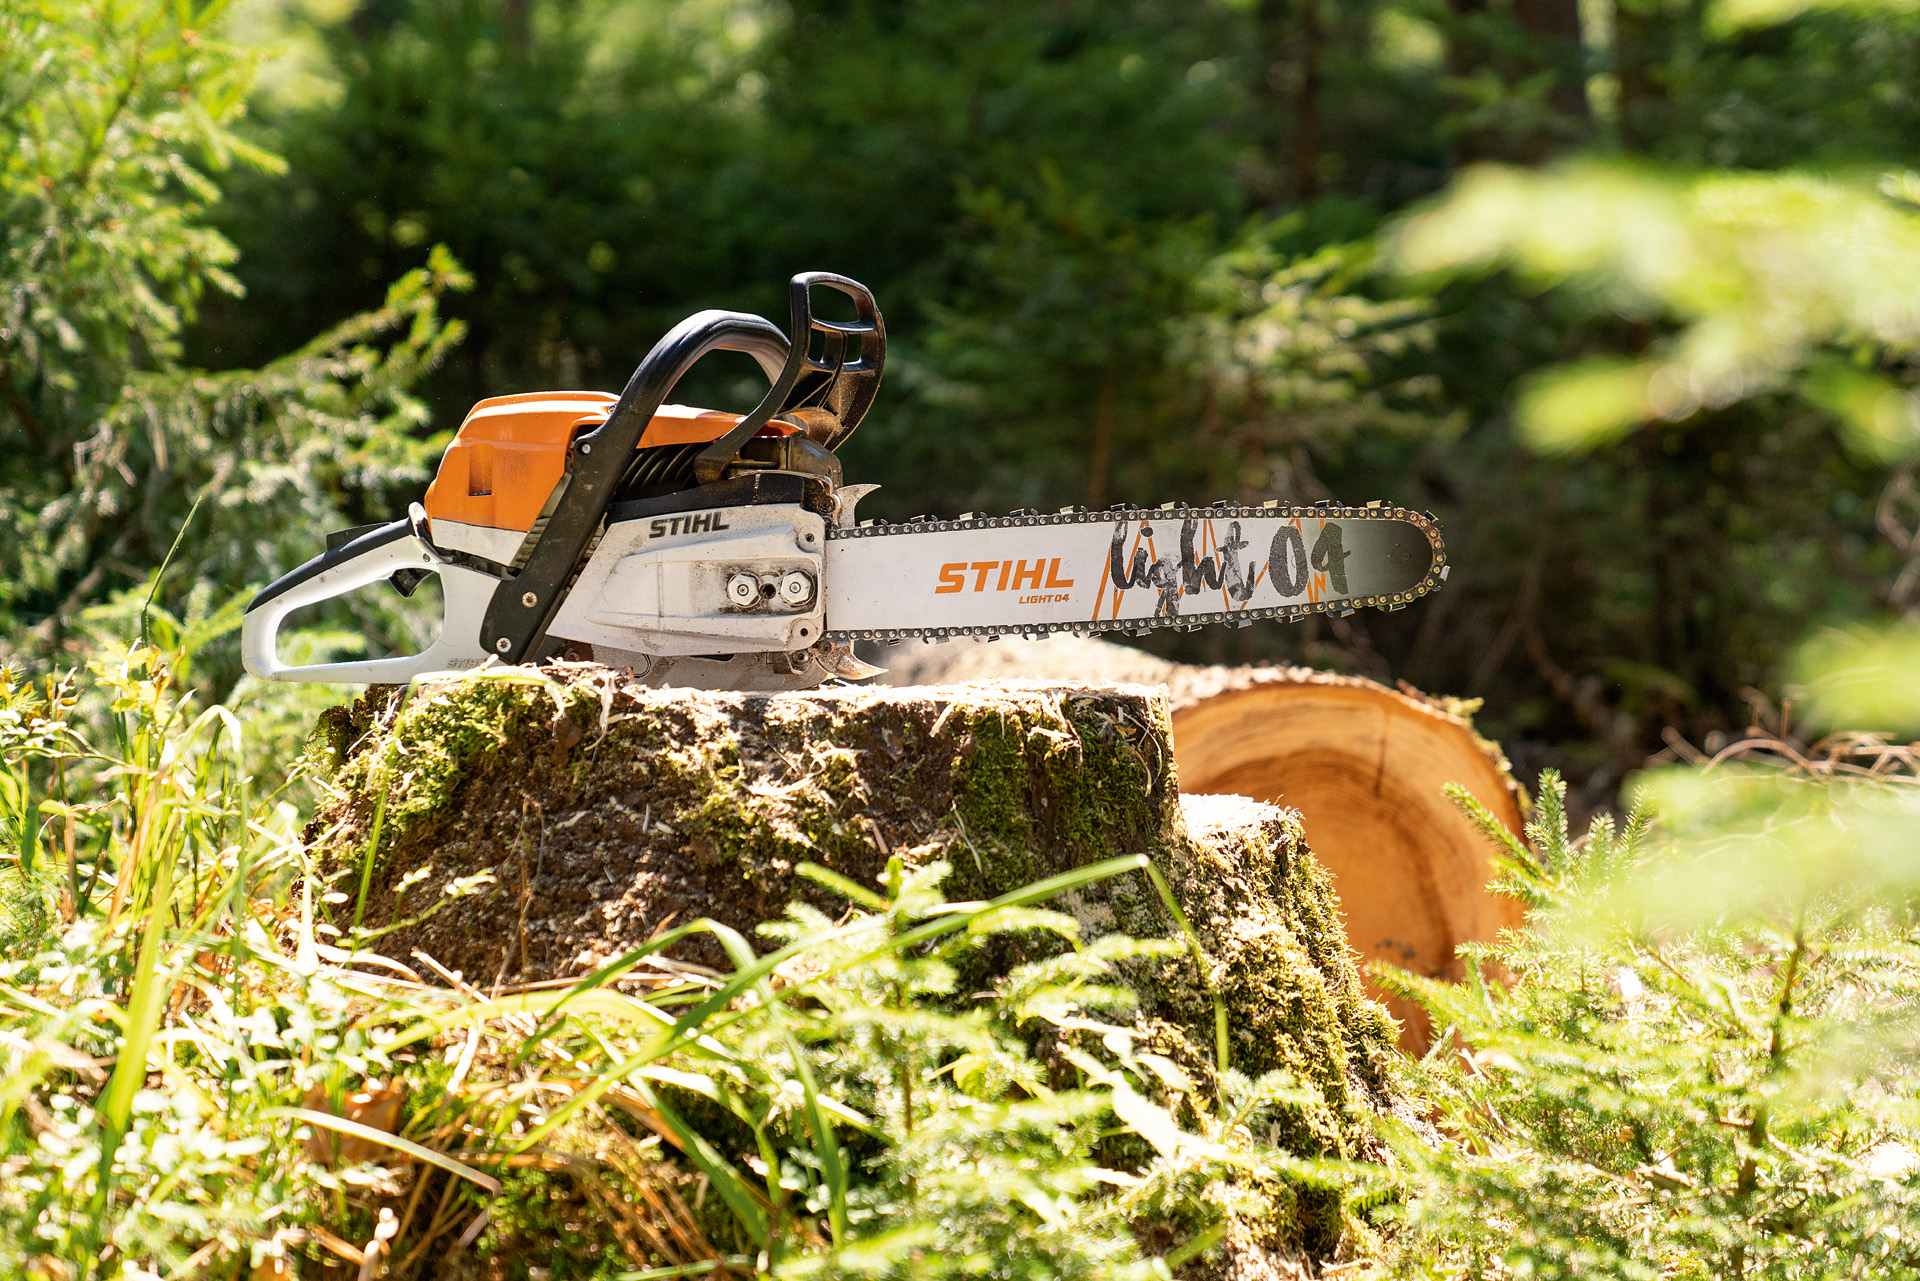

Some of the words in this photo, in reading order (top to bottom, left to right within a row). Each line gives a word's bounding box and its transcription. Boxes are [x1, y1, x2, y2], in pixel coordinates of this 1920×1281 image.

[649, 511, 730, 539] STIHL
[934, 557, 1075, 595] STIHL
[1110, 519, 1256, 618] light
[1268, 521, 1352, 598] 04
[1018, 594, 1054, 605] LIGHT
[1053, 593, 1070, 603] 04
